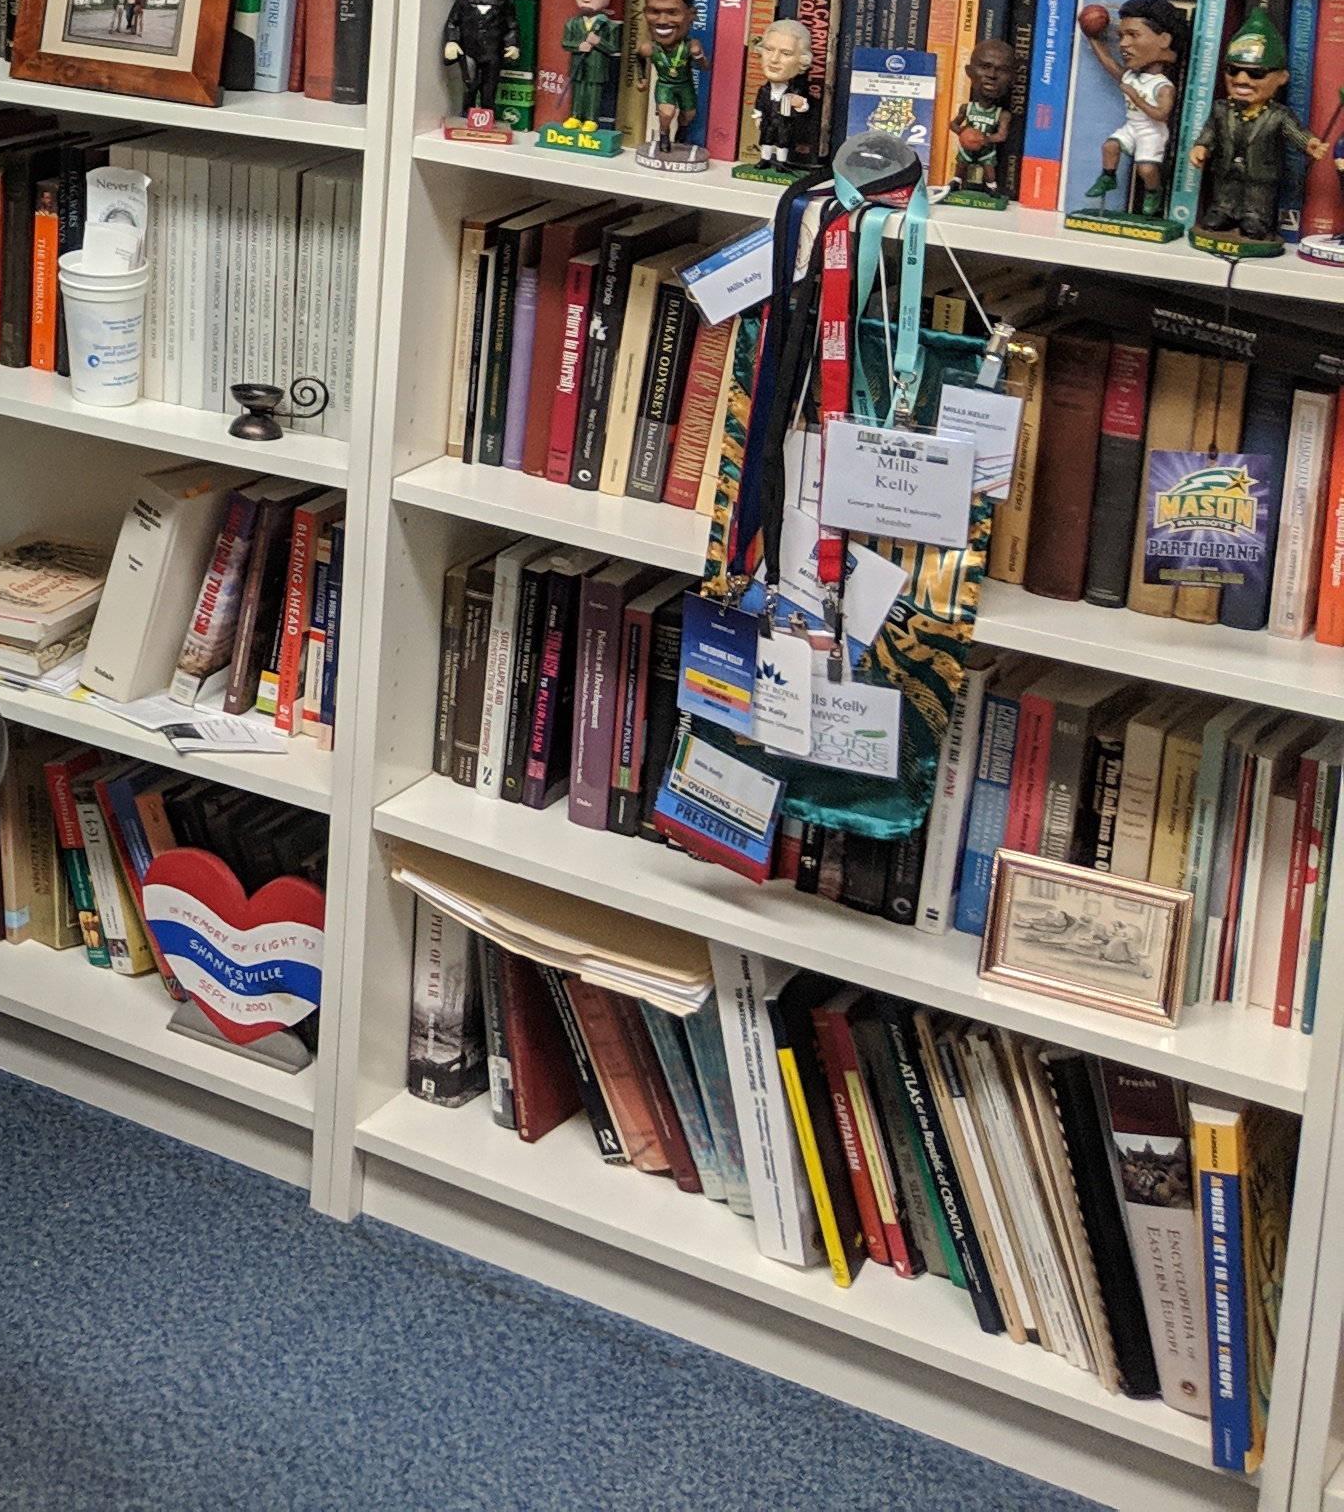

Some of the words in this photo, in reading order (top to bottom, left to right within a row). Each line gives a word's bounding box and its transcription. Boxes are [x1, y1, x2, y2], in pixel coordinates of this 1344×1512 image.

[810, 7, 830, 80] CARNIVAL
[1013, 64, 1027, 114] SERBS
[1040, 51, 1056, 86] History
[545, 128, 574, 149] Doc
[577, 131, 602, 151] Nix
[906, 124, 928, 145] 2
[36, 237, 46, 260] THE
[1065, 218, 1118, 237] MARQUISE
[1120, 223, 1164, 242] MOORE
[34, 260, 46, 326] HABSBURGS
[726, 279, 745, 294] Mills
[744, 271, 762, 290] Kelly
[663, 298, 681, 354] BALKAN
[650, 356, 674, 420] ODYSSEY
[943, 405, 966, 415] MILLS
[967, 409, 990, 420] KELLY
[646, 423, 659, 453] David
[671, 393, 716, 482] TRANSYLVANIA
[639, 453, 654, 478] Owen
[875, 474, 919, 496] Kelly
[876, 455, 919, 474] Mills
[847, 498, 875, 509] George
[876, 501, 901, 512] Mason
[904, 506, 942, 519] University
[876, 516, 912, 529] Member
[1158, 495, 1254, 528] MASON
[210, 503, 244, 575] AMERICAN
[291, 523, 307, 585] BLAZING
[1147, 538, 1260, 561] PARTICIPANT
[193, 574, 223, 637] TOURISM
[286, 588, 304, 637] AHEAD
[497, 649, 509, 686] COLLAPSE
[543, 629, 562, 678] STALINISM
[532, 689, 549, 754] PLURALISM
[831, 696, 868, 715] Kelly
[180, 910, 228, 945] MEMORY
[231, 942, 248, 953] OF
[254, 936, 298, 953] FLIGHT
[429, 912, 443, 946] PITY
[189, 939, 284, 984] SHANKSVILLE
[245, 1002, 274, 1012] 2001
[426, 971, 440, 1000] WAR
[831, 1091, 862, 1173] CAPITALISM
[898, 1062, 922, 1106] ATLAS
[937, 1188, 966, 1241] CROATIA
[1210, 1175, 1227, 1233] MODERN
[1146, 1225, 1166, 1295] EASTERN
[1161, 1297, 1180, 1355] EUROPE
[1166, 1228, 1195, 1342] ENCYCLOPEDIA
[1215, 1283, 1232, 1344] EASTERN
[1218, 1345, 1234, 1400] EUROPE
